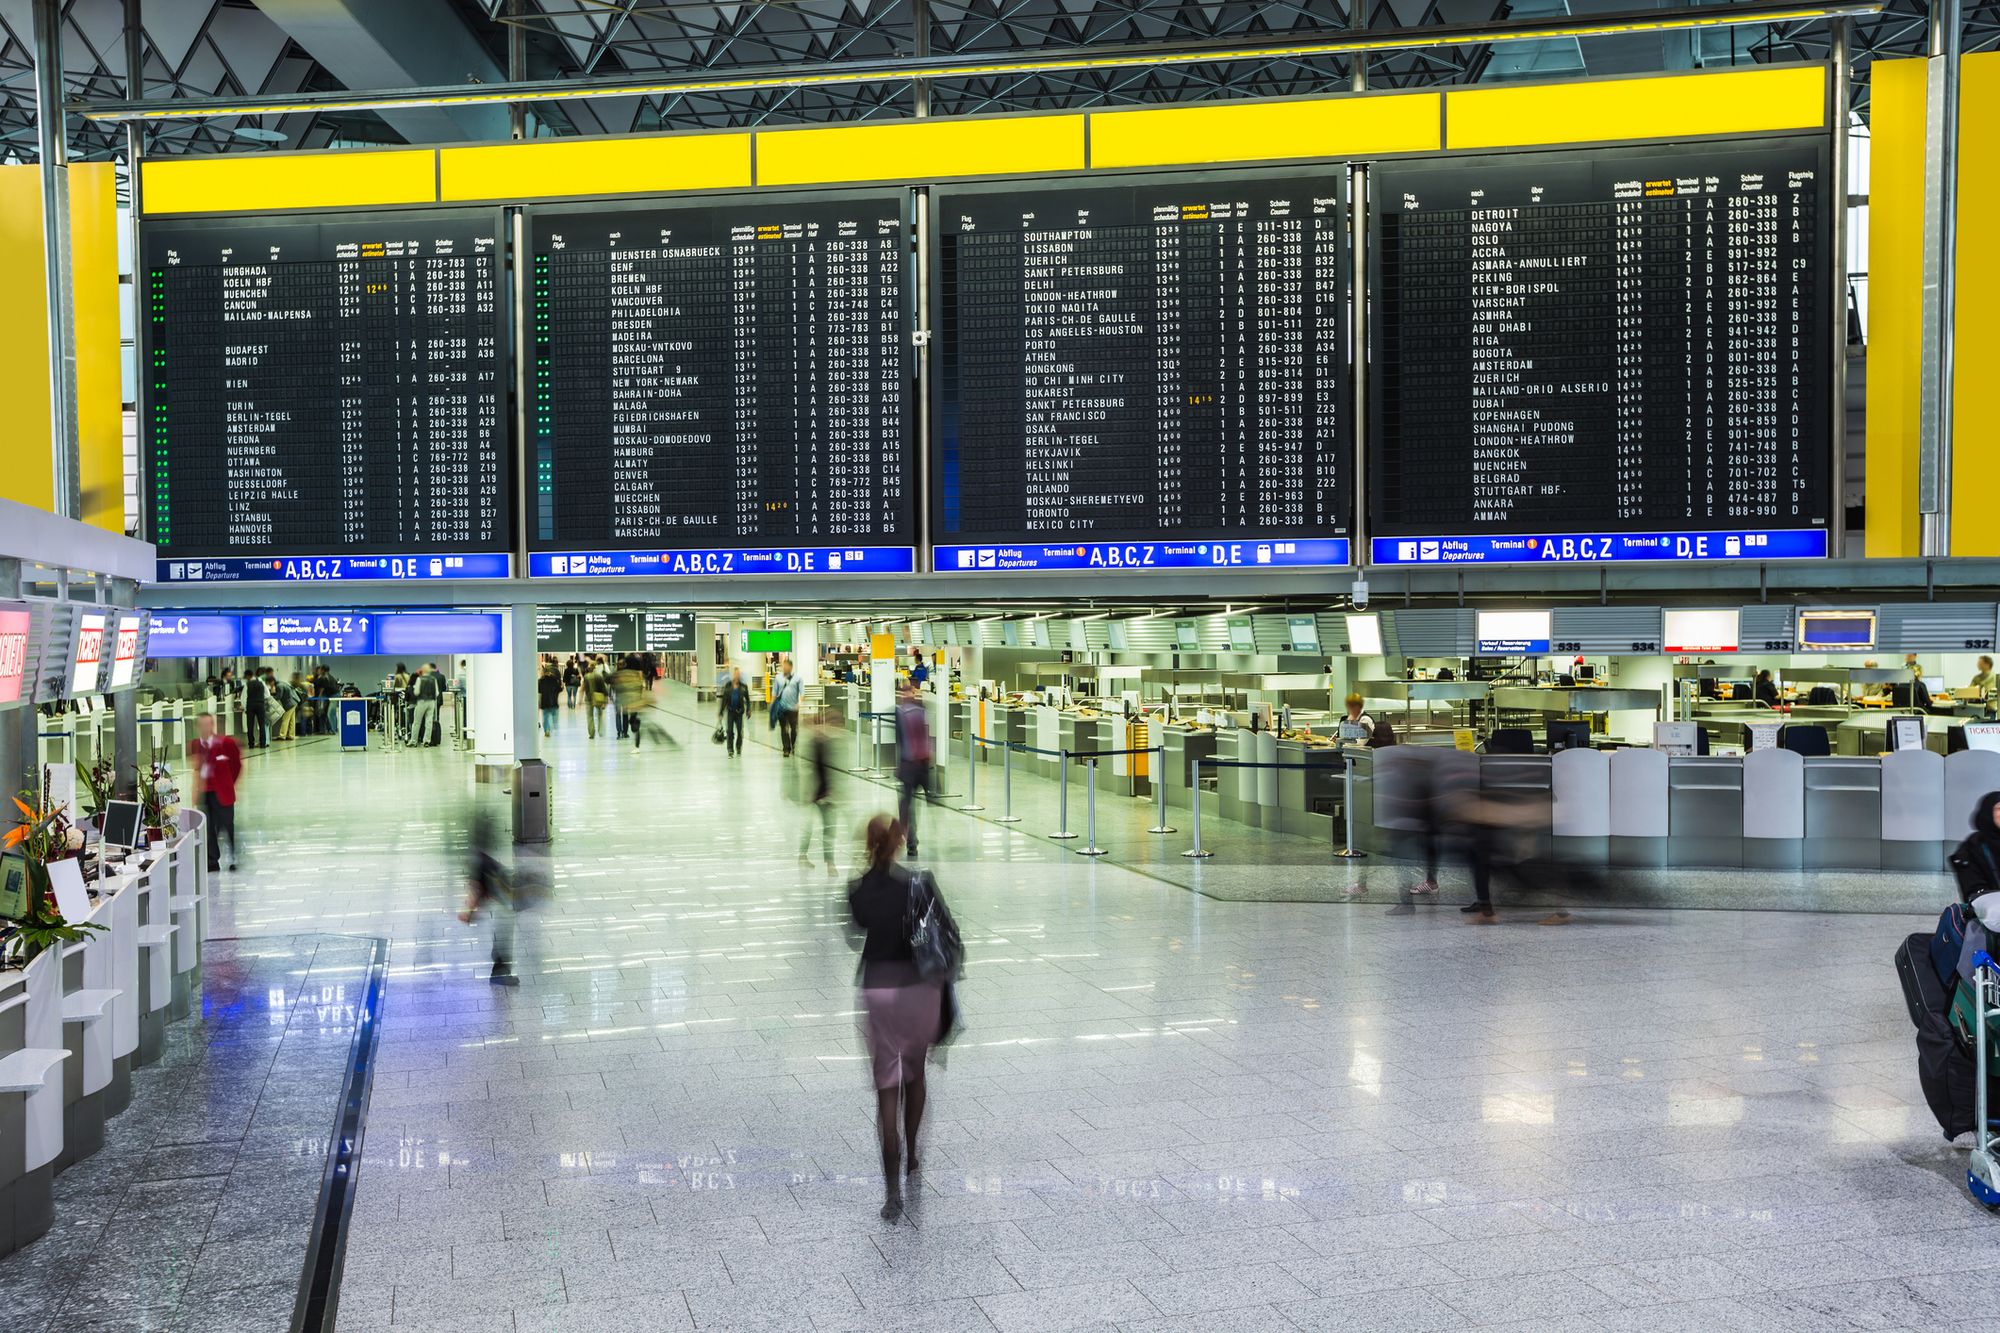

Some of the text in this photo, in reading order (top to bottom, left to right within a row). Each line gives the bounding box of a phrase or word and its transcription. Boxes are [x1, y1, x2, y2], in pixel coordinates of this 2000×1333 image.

[1472, 208, 1518, 220] DETROIT
[1728, 195, 1778, 207] 260-338
[1024, 230, 1091, 241] SOUTHAMPTON
[1257, 221, 1302, 231] 911-912
[611, 247, 720, 260] MUENSTER OSNABRUECK
[224, 267, 266, 276] HURGHADA
[427, 259, 465, 268] 773-783
[477, 258, 487, 266] C7
[1473, 257, 1587, 270] ASMARA-ANNULLIERT
[224, 278, 272, 287] KOELN HBF
[224, 289, 267, 298] MUENCHEN
[427, 282, 466, 291] 260-338
[477, 281, 493, 290] A11
[1473, 283, 1559, 296] KIEW-BORISPOL
[612, 296, 662, 306] VANCOUVER
[1025, 290, 1117, 302] LONDON-HEATHROW
[612, 307, 680, 317] PHILADELOHIA
[1025, 303, 1099, 314] TOKIO NAQITA
[225, 310, 311, 321] MAILAND-MALPENSA
[1026, 325, 1143, 338] LOS ANGELES-HOUSTON
[226, 345, 268, 355] BUDAPEST
[612, 341, 692, 352] MOSKAU-VNTKOVO
[613, 365, 664, 375] STUTTGART
[226, 380, 248, 388] WIEN
[613, 376, 698, 387] NEW YORK-NEWARK
[1473, 382, 1609, 396] MAILAND-ORIO ALSERIO
[1026, 400, 1056, 410] SANKT
[1063, 398, 1124, 409] PETERSBURG
[1259, 393, 1303, 403] 897-899
[1317, 392, 1329, 401] E3
[227, 412, 291, 422] BERLIN-TEGEL
[614, 411, 699, 422] FGIEDRICHSHAFEN
[1026, 411, 1106, 422] SAN FRANCISCO
[227, 424, 276, 433] AMSTERDAM
[1474, 421, 1574, 434] SHANGHAI PUDONG
[614, 434, 711, 445] MOSKAU-DOMODEDOVO
[1026, 447, 1080, 458] REYKJAVIK
[228, 457, 260, 466] OTTAWA
[430, 453, 468, 461] 769-772
[480, 452, 496, 461] B48
[1026, 460, 1074, 470] HELSINKI
[228, 468, 282, 477] WASHINGTON
[614, 470, 648, 479] DENVER
[229, 479, 287, 488] DUESSELDORF
[229, 490, 298, 500] LEIPZIG HALLE
[1474, 484, 1567, 497] STUTTGART HBF.
[1027, 494, 1144, 506] MOSKAU-SHEREMETYEVO
[615, 505, 660, 514] LISSABON
[830, 500, 870, 510] 260-338
[230, 513, 271, 522] ISTANBUL
[615, 515, 717, 526] PARIS-CH.DE GAULLE
[1027, 519, 1094, 530] MEXICO CITY
[229, 535, 271, 544] BRUESSEL
[1442, 541, 1468, 551] Abflug
[1491, 539, 1525, 549] Terminal
[1542, 538, 1612, 560] A,B,C,Z
[1623, 537, 1658, 547] Terminal
[1676, 537, 1708, 559] D,E
[998, 548, 1022, 559] Abflug
[1043, 545, 1241, 568] Terminal A,B,C,Z Terminal D,E
[1442, 551, 1485, 561] Departures
[588, 555, 611, 566] Abflug
[630, 554, 659, 564] Terminal
[674, 554, 733, 574] A,B,C,Z
[743, 552, 772, 562] Terminal
[788, 552, 814, 572] D,E
[999, 558, 1037, 568] Departures
[205, 562, 226, 571] Abflug
[245, 561, 272, 570] Terminal
[285, 560, 341, 580] A,B,C,Z
[350, 559, 377, 568] Terminal
[392, 558, 417, 578] D,E
[589, 565, 625, 575] Departures
[205, 571, 240, 580] Departures
[280, 618, 299, 626] Abflug
[280, 618, 352, 634] Departures A,B,Z
[319, 638, 343, 655] D,E
[1558, 642, 1581, 652] 535
[1632, 642, 1655, 652] 534
[1765, 641, 1789, 650] 533
[1965, 640, 1990, 649] 532
